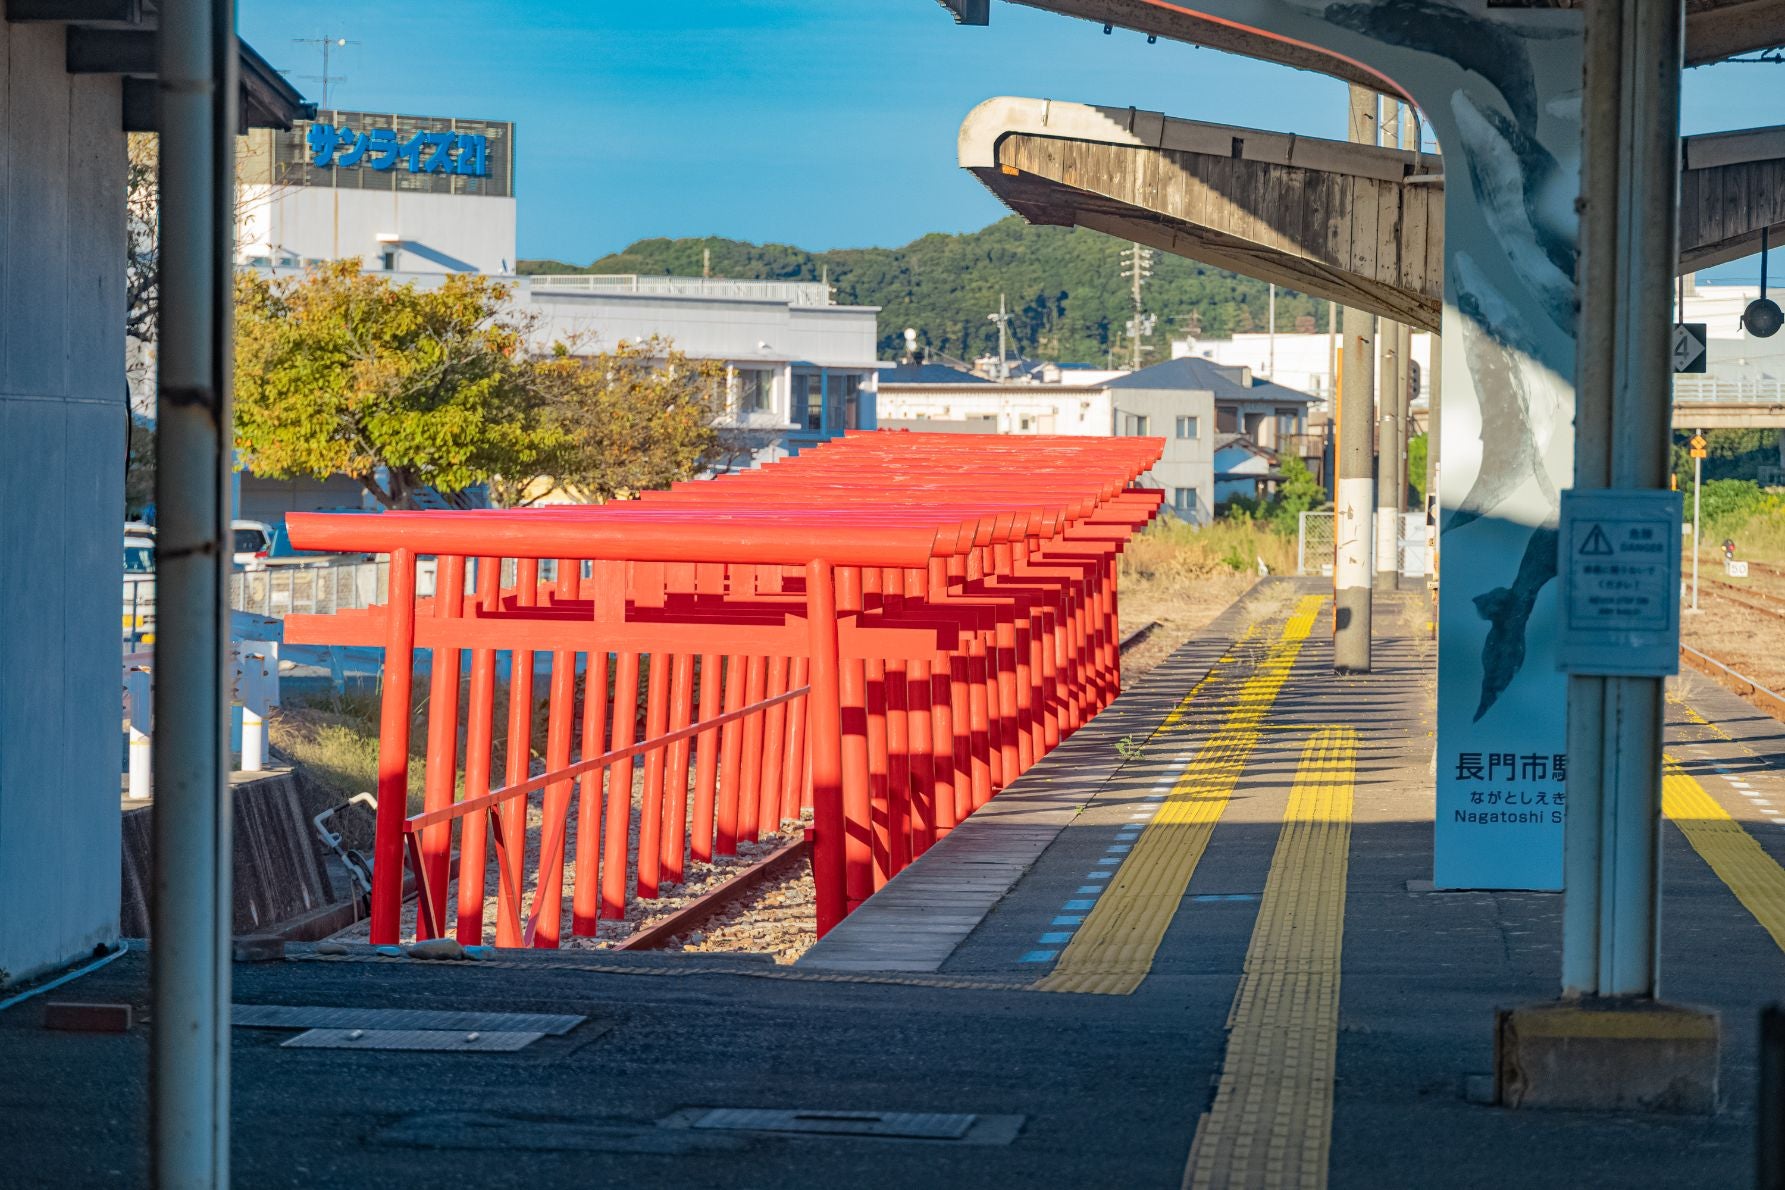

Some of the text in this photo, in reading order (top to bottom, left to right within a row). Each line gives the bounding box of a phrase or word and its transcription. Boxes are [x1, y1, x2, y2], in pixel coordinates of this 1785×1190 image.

[307, 123, 487, 177] サンライズ21
[1674, 335, 1690, 360] 4
[1455, 810, 1567, 824] Nagatoshi S
